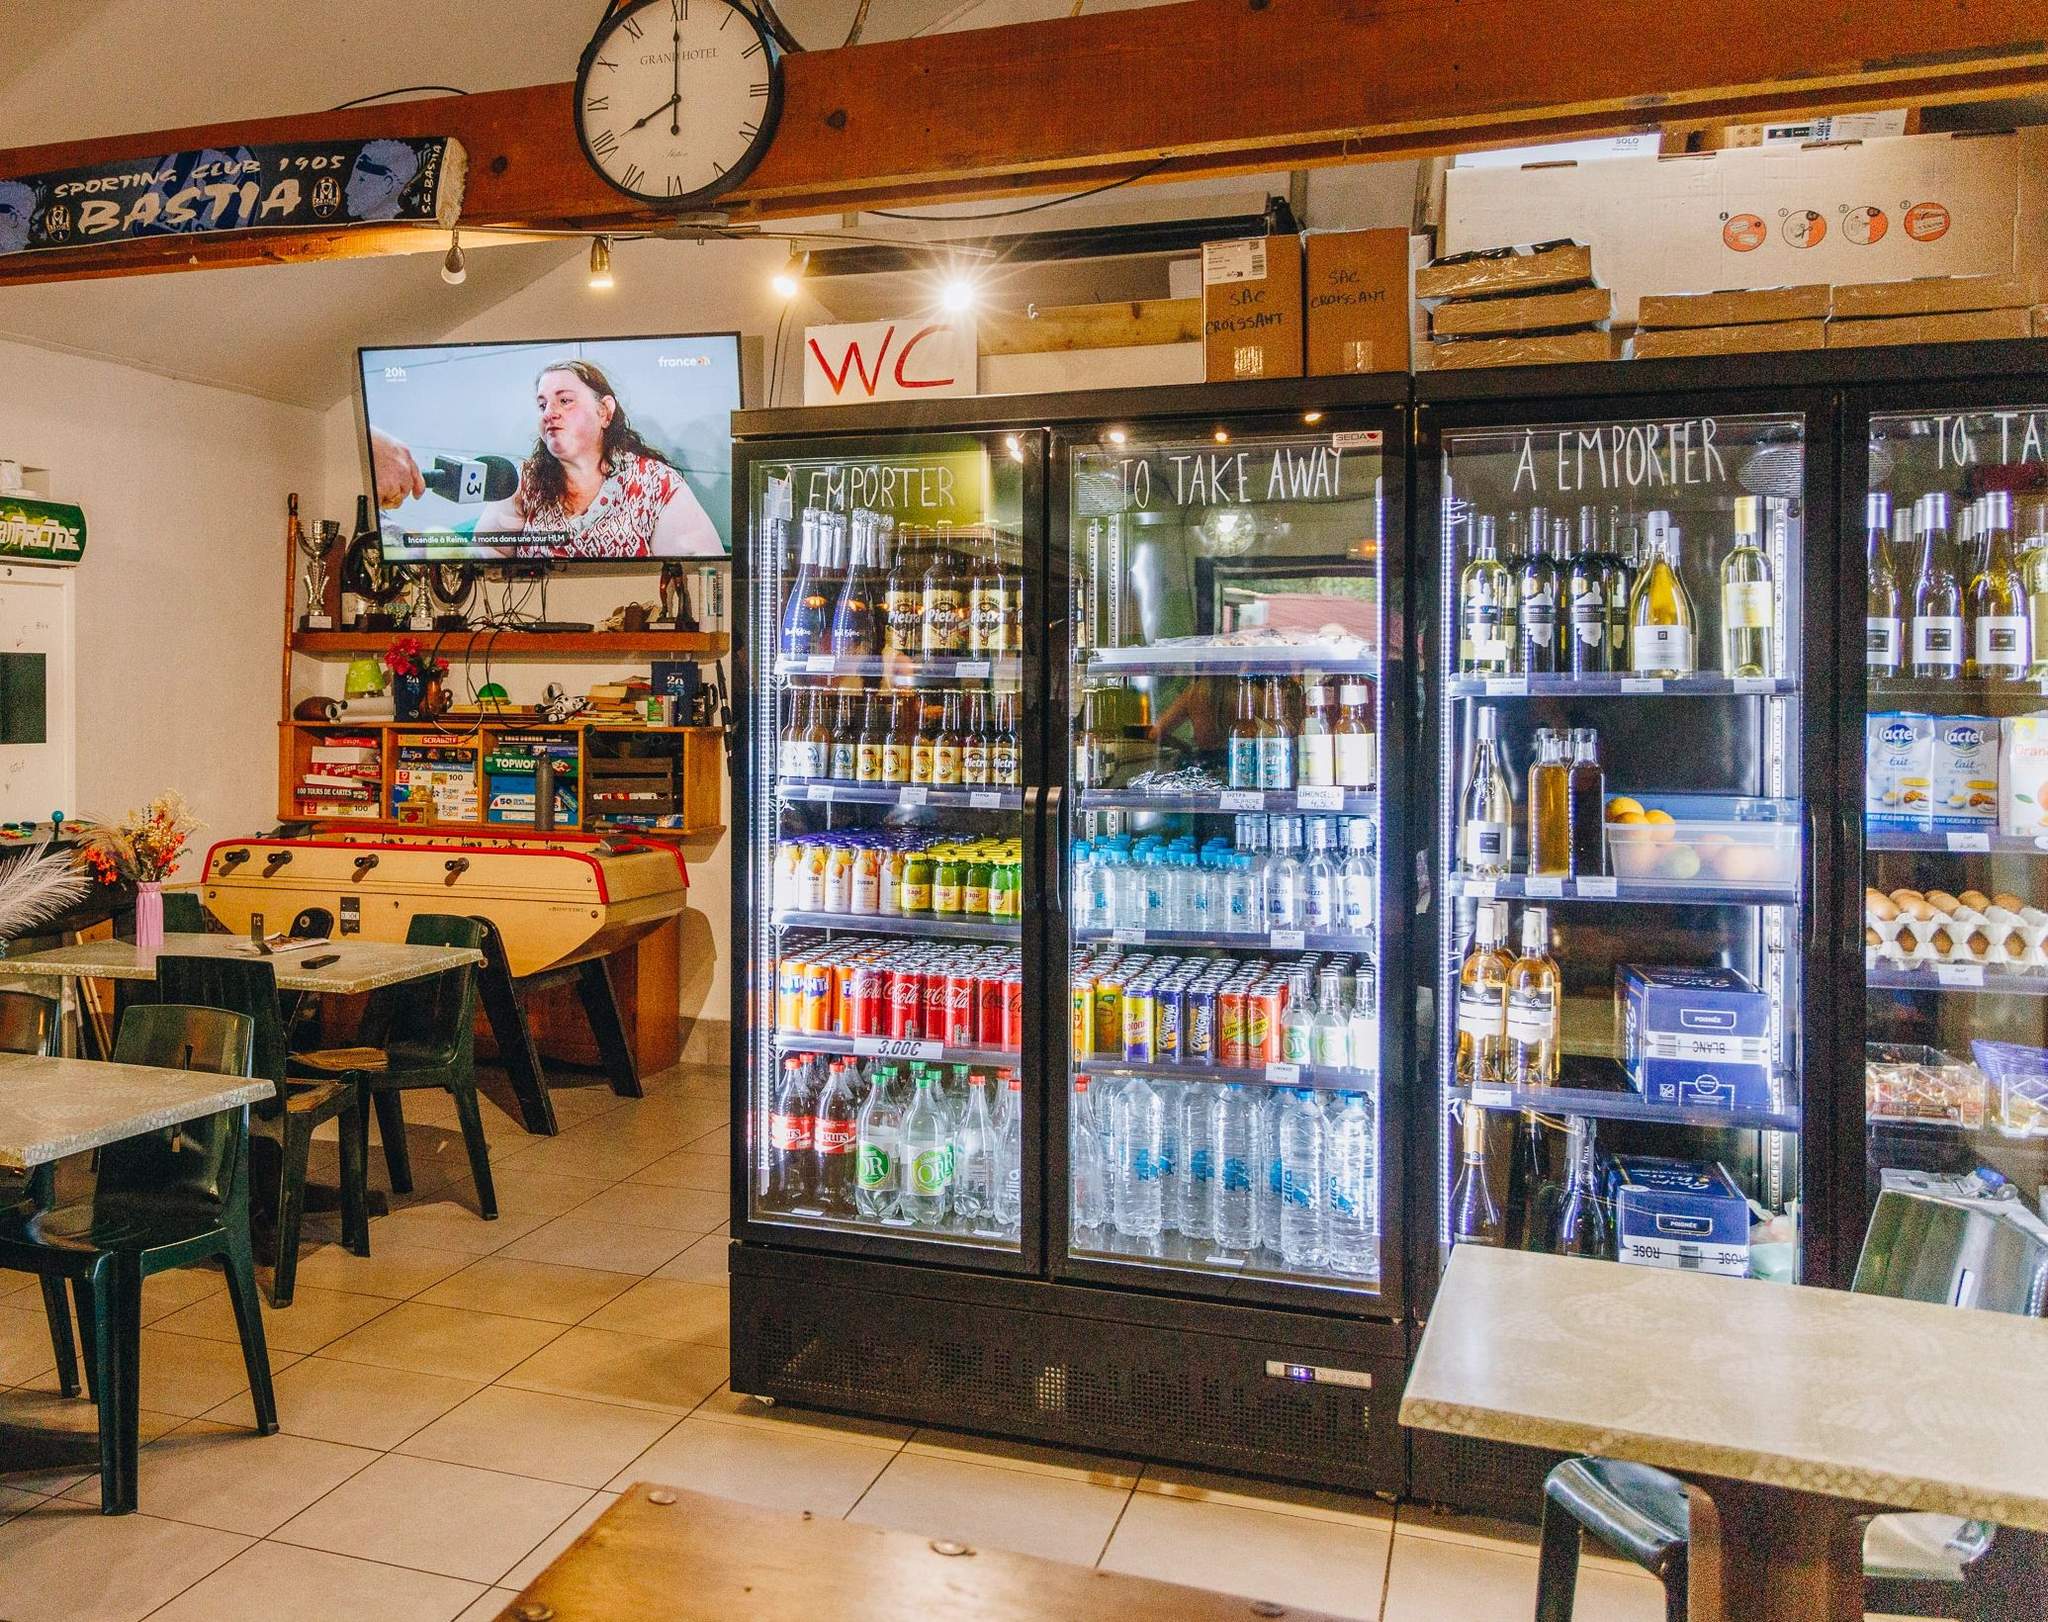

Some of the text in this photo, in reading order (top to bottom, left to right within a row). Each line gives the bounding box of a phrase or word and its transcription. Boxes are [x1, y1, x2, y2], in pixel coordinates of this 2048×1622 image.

[682, 47, 719, 61] HOTEL
[1616, 137, 1639, 145] SOLO
[54, 154, 346, 199] SPORTING CLUB 1905
[78, 178, 303, 235] BASTIA
[1328, 270, 1361, 284] SAC
[1229, 289, 1265, 306] SAC
[1310, 289, 1386, 309] CROISSANT
[1205, 312, 1284, 336] CROISSANT
[807, 324, 955, 397] WC
[384, 367, 407, 378] 20h
[1933, 415, 1968, 470] TO
[1513, 417, 1726, 492] À EMPORTER
[1119, 446, 1343, 510] TO TAKE AWAY
[408, 535, 438, 544] Incendie
[478, 535, 498, 543] morts
[499, 535, 516, 543] dans
[548, 534, 564, 542] HLM
[332, 788, 352, 796] CARTES
[878, 1039, 922, 1057] 3.00€
[1692, 1040, 1726, 1055] BLANC
